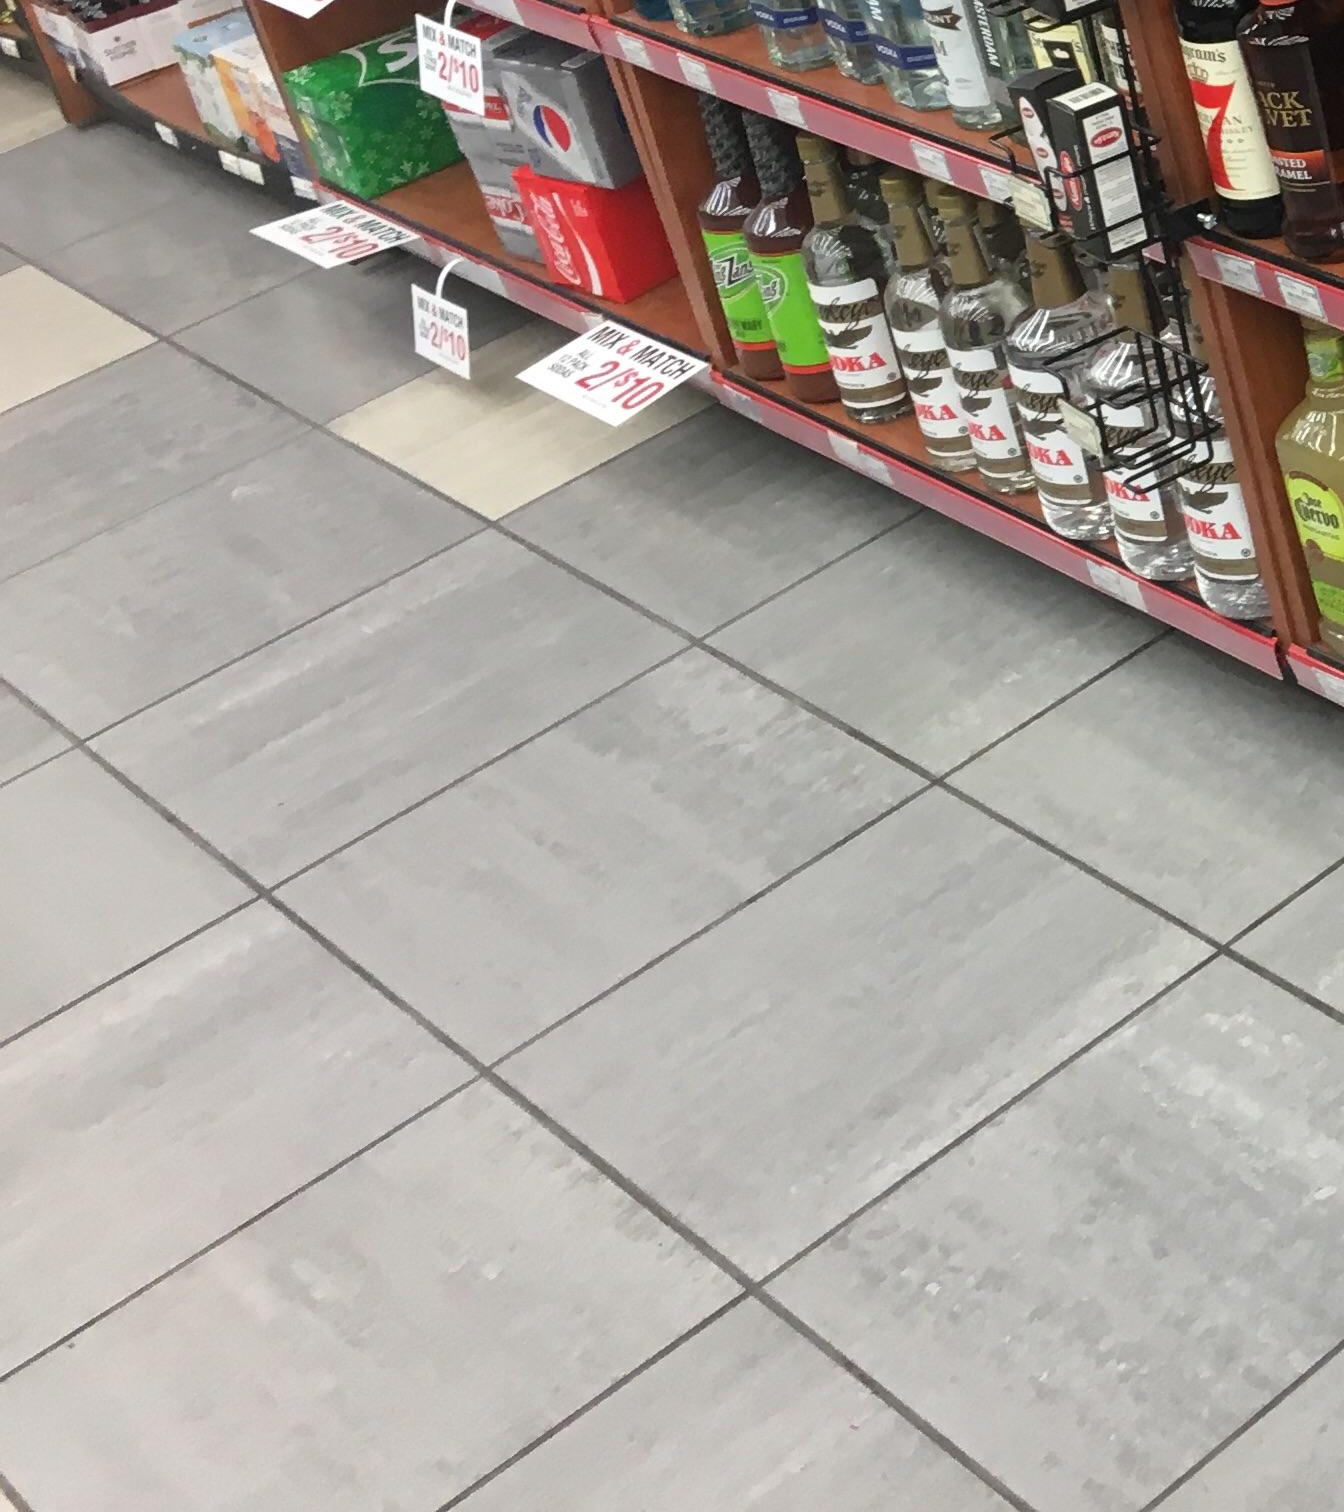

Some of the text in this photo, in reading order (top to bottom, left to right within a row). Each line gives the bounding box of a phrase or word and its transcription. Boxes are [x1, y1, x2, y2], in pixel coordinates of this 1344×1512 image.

[422, 24, 477, 59] MIX & MATCH
[438, 52, 479, 93] 2/$10
[357, 220, 411, 244] MATCH
[439, 307, 464, 329] MATCH
[587, 326, 695, 380] MIX & MATCH
[575, 360, 664, 410] 2/$10
